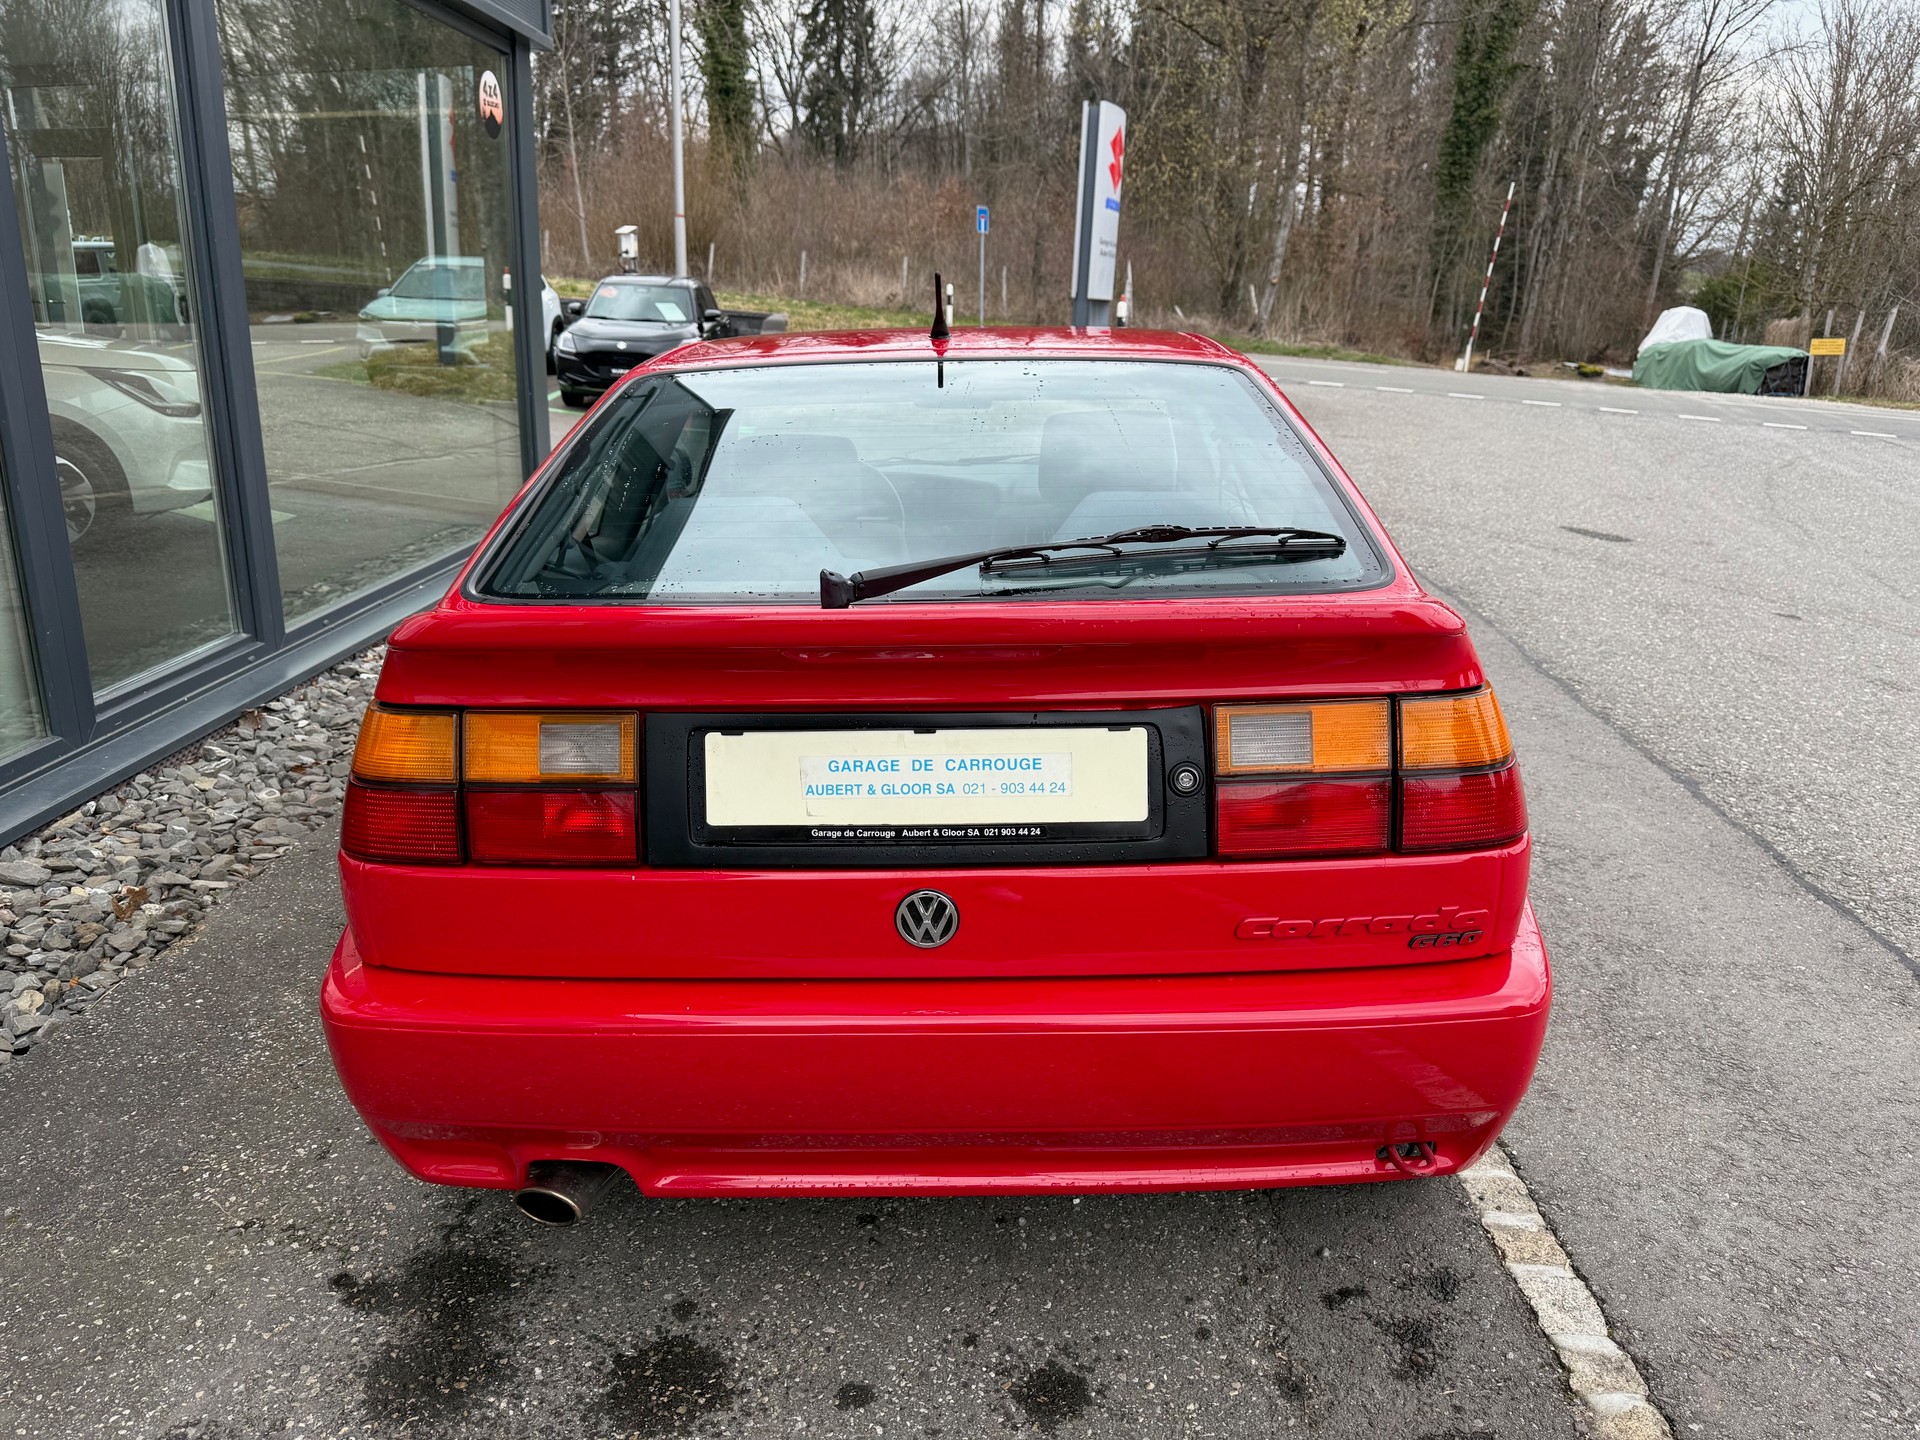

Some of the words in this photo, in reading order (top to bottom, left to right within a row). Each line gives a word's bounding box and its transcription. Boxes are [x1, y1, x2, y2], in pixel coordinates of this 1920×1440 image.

[828, 759, 900, 773] GARAGE
[911, 759, 934, 772] DE
[945, 758, 1042, 772] CARROUGE
[805, 784, 862, 796] AUBERT
[867, 783, 876, 795] &
[881, 783, 932, 795] GLOOR
[936, 783, 955, 795] SA
[962, 783, 985, 795] 021
[1000, 782, 1025, 794] 903
[1029, 782, 1045, 794] 44
[1049, 781, 1066, 794] 24
[811, 829, 842, 838] Garage
[844, 829, 855, 837] de
[856, 829, 896, 838] Carrouge
[902, 829, 931, 837] Aubert
[932, 829, 940, 837] &
[941, 828, 966, 837] Gloor
[967, 828, 980, 837] SA
[984, 828, 999, 836] 021
[1001, 828, 1017, 836] 903
[1018, 827, 1029, 836] 44
[1030, 827, 1041, 836] 24
[1408, 931, 1483, 949] G60
